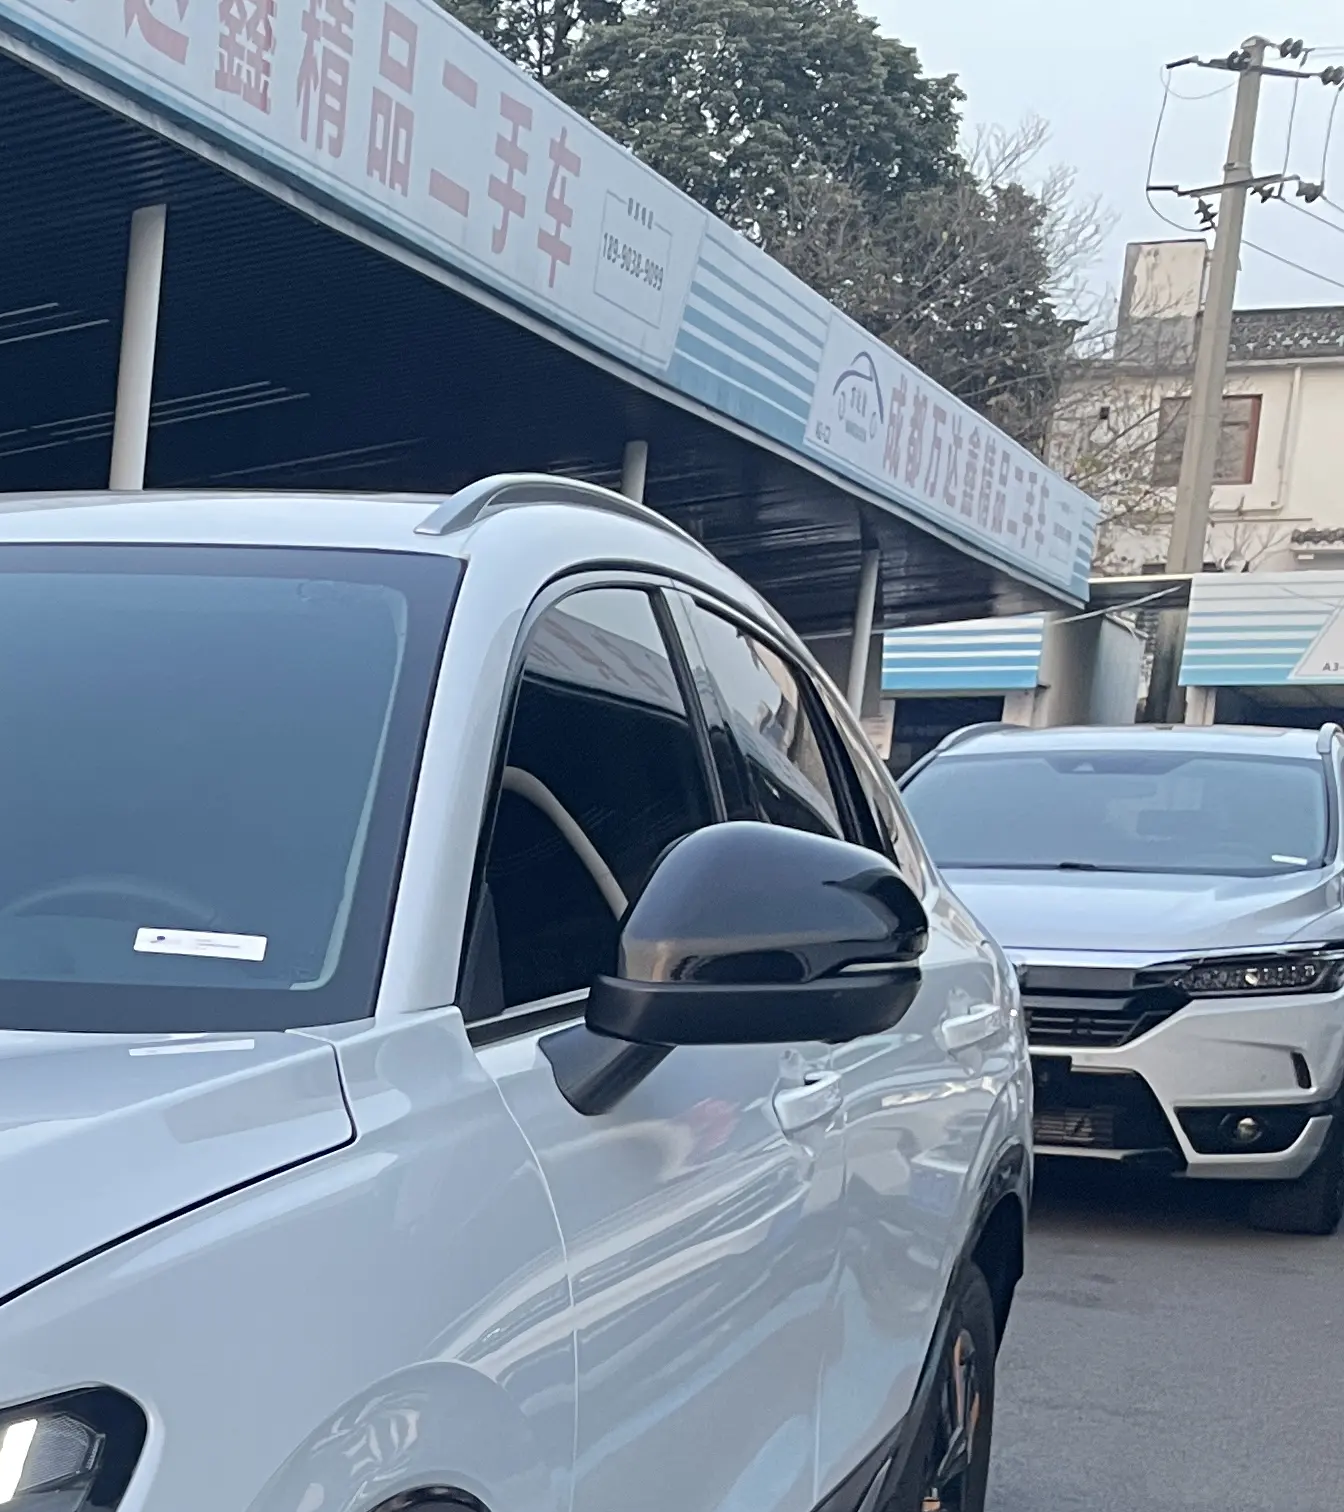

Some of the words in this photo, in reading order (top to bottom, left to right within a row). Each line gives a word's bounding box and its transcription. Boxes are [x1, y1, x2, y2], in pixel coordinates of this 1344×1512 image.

[883, 373, 1050, 559] 成都万达鑫精品二手车
